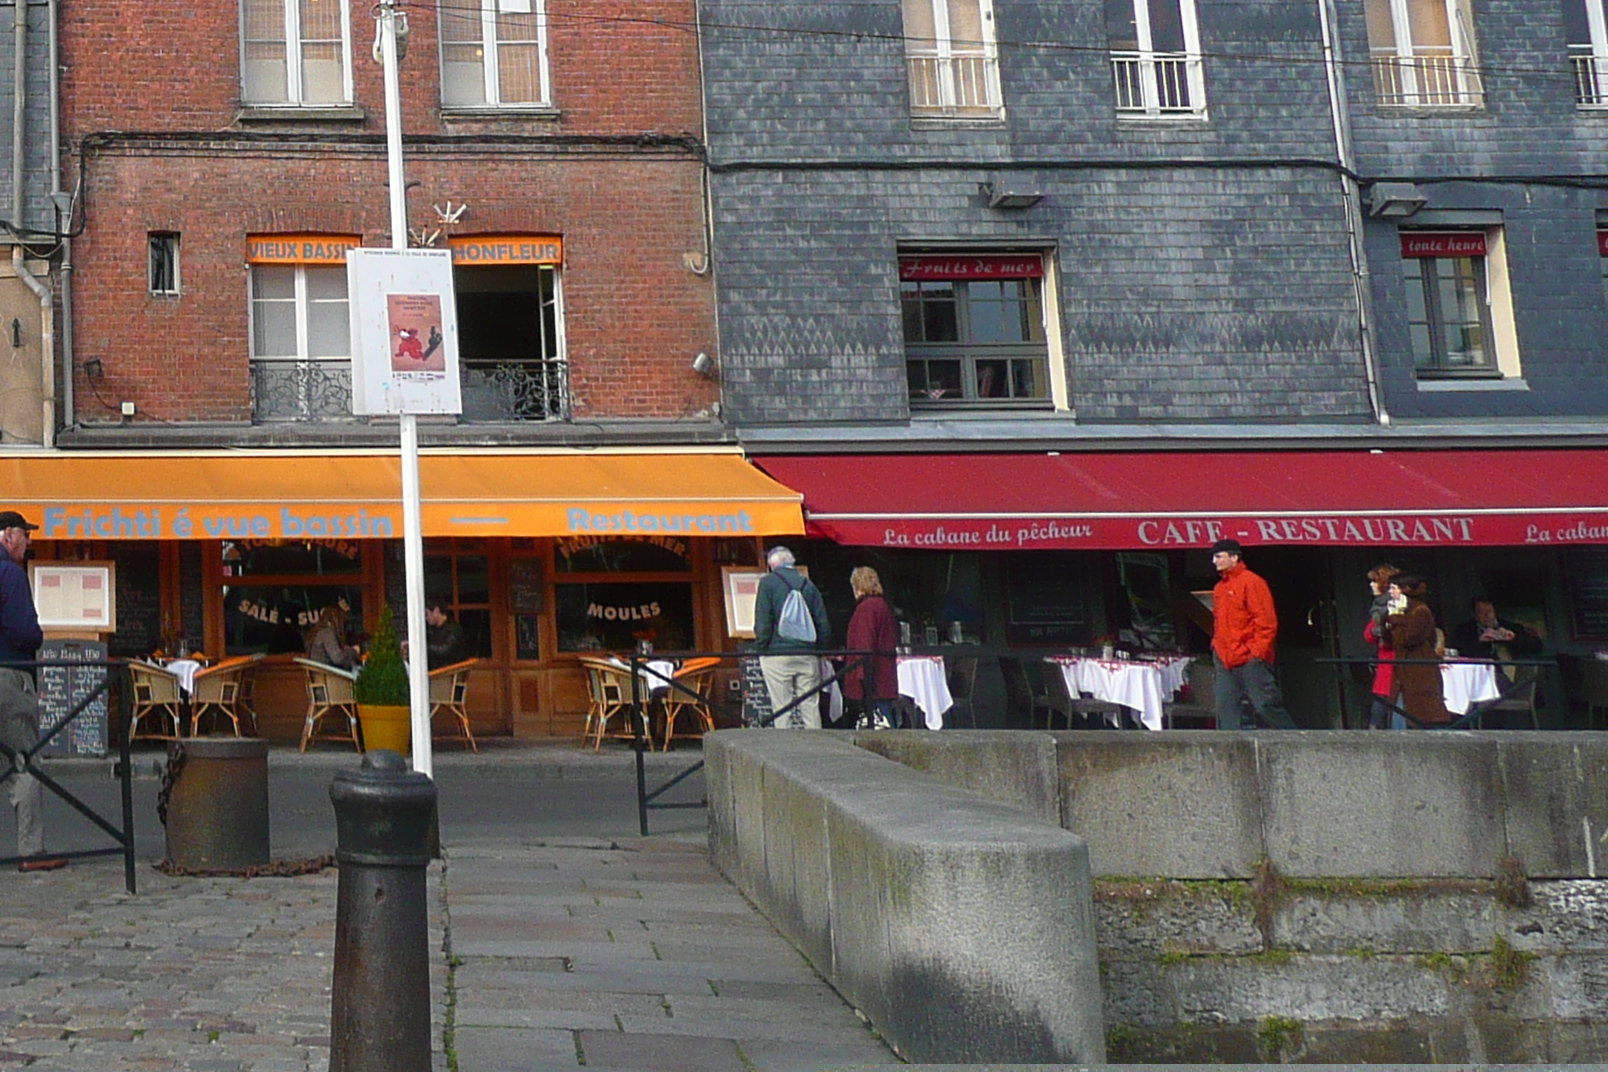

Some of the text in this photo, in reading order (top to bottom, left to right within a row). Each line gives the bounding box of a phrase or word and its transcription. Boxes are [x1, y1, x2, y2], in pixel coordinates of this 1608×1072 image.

[248, 242, 298, 259] VIEUX
[452, 242, 559, 260] HONFLEUR
[1408, 236, 1485, 251] toute heure
[901, 258, 1034, 277] Fruits de mer
[43, 504, 168, 537] Frichti
[203, 513, 270, 537] vue
[280, 507, 393, 537] bassin
[565, 507, 755, 533] Restaurant
[1255, 517, 1474, 541] RESTAURANT
[883, 520, 1093, 546] La cabane du pêcheur
[1524, 525, 1551, 543] La
[298, 595, 351, 626] SUÉ
[586, 601, 662, 621] MOULES
